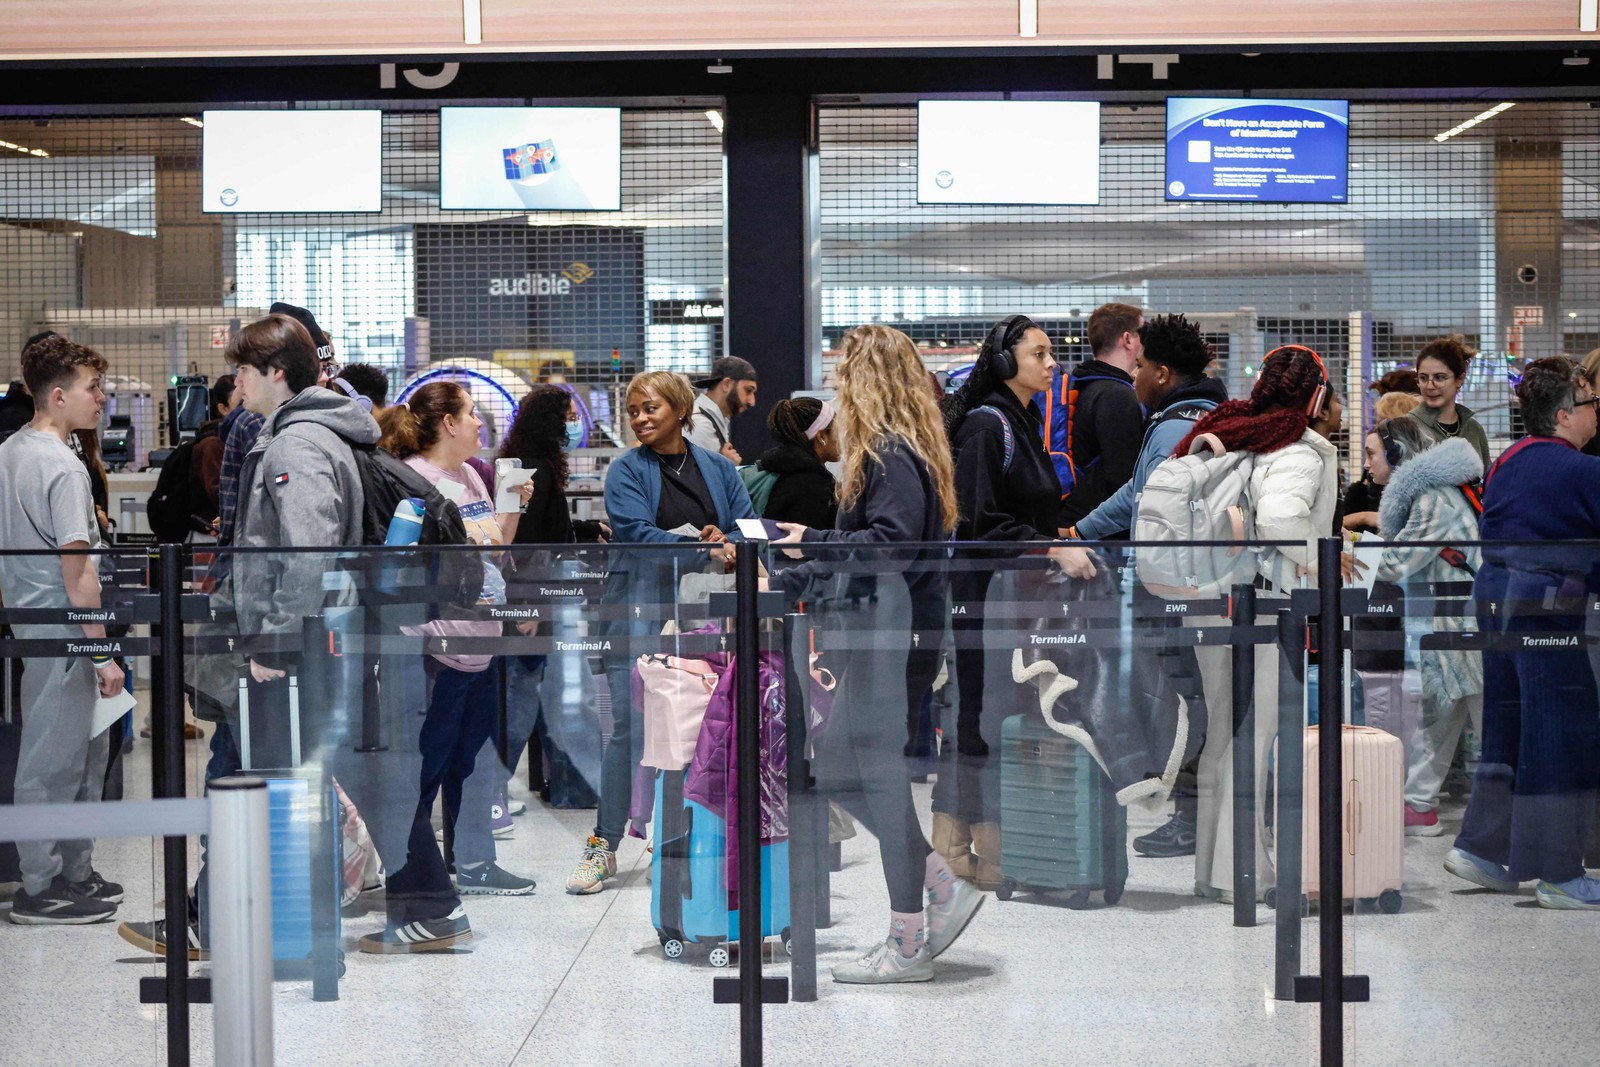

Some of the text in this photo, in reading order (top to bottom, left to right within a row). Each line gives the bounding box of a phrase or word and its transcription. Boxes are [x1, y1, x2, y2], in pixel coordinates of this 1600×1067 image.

[1226, 119, 1247, 127] Have
[1259, 120, 1302, 129] Acceptable
[1303, 120, 1325, 128] Form
[1230, 129, 1240, 137] of
[489, 273, 571, 295] audible
[571, 570, 604, 579] Terminal
[540, 587, 584, 596] Terminal A
[490, 608, 540, 617] Terminal A
[958, 606, 967, 614] A
[1165, 604, 1188, 613] EWR
[1386, 604, 1394, 613] A
[67, 612, 116, 621] Terminal A
[1030, 634, 1087, 644] Terminal A
[1522, 636, 1579, 646] Terminal A
[66, 642, 121, 653] Terminal A
[556, 641, 611, 651] Terminal A
